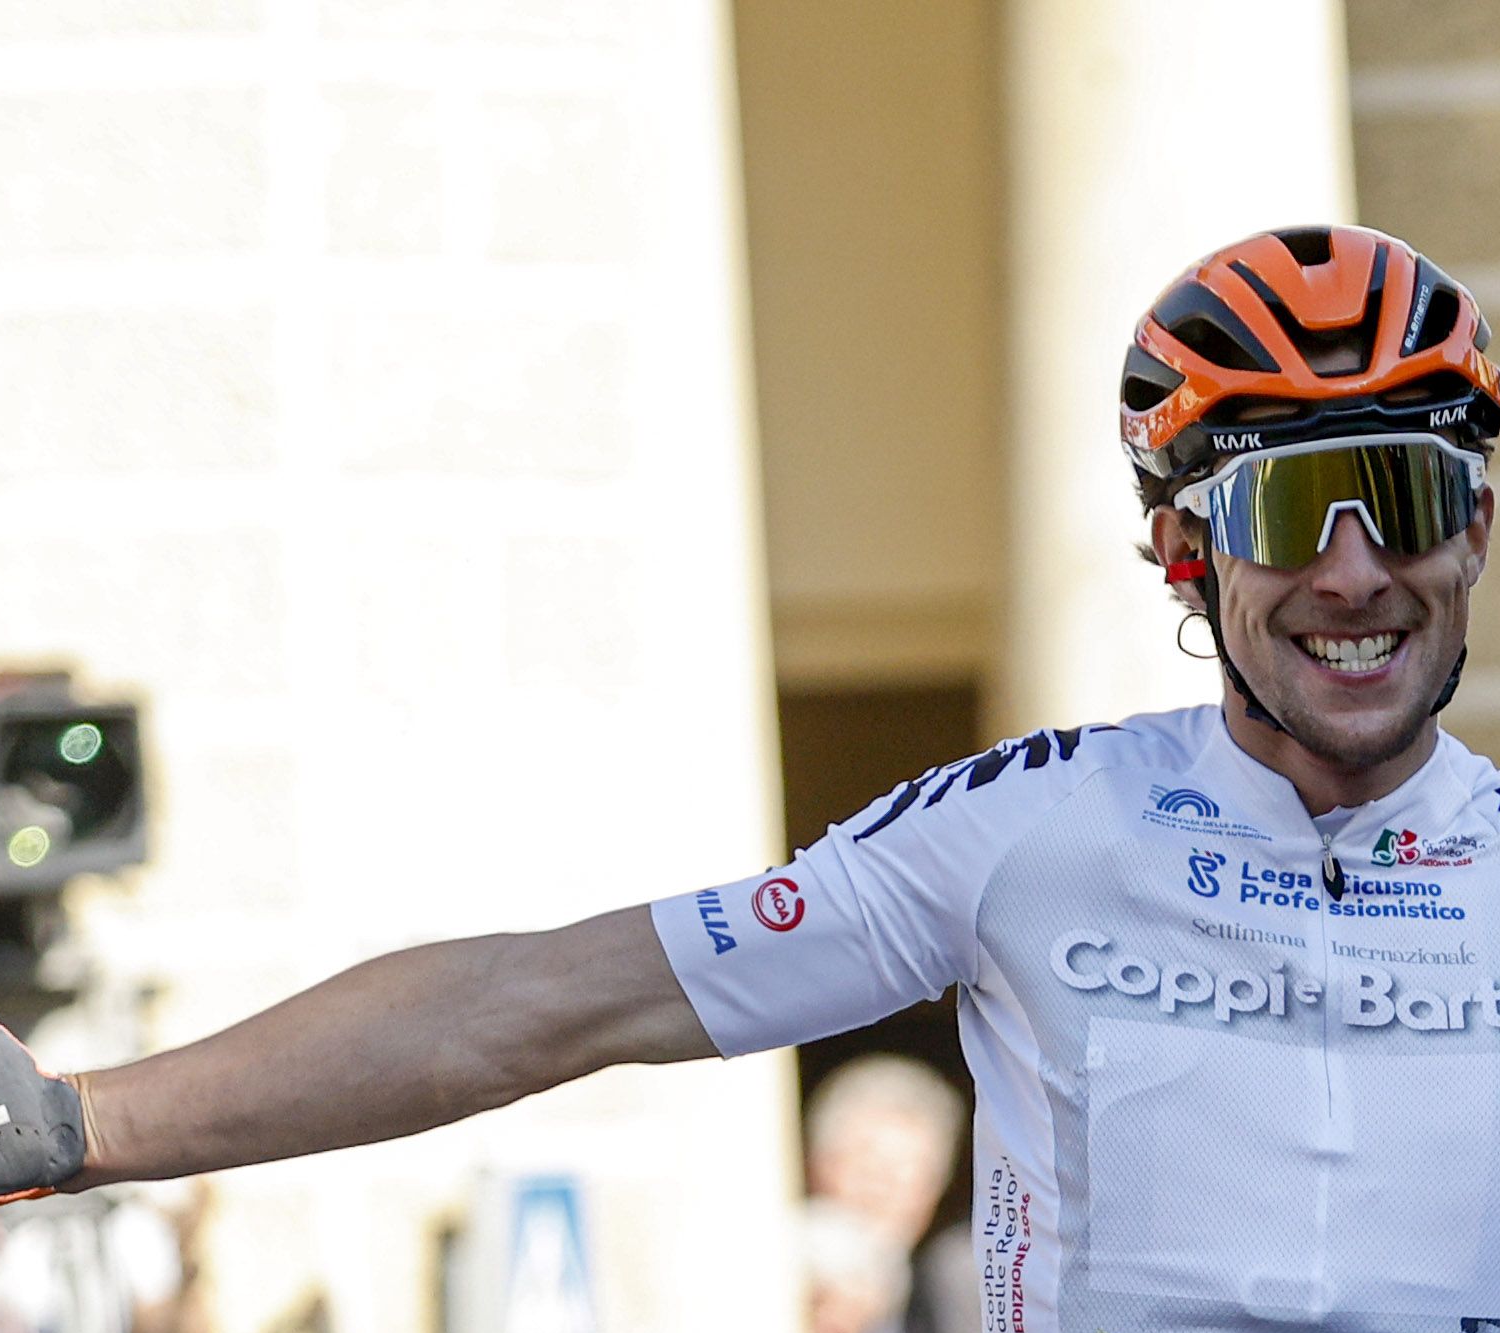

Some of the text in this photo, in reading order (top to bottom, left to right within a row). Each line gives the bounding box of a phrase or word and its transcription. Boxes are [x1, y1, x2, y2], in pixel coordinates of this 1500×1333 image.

[1429, 405, 1468, 427] KASK
[1213, 433, 1263, 451] KASK
[1241, 862, 1312, 890] Lega
[1190, 917, 1478, 966] Settimana Internazionale
[1049, 928, 1287, 1023] Coppi
[1297, 976, 1323, 1004] e
[1019, 1192, 1032, 1238] 2026
